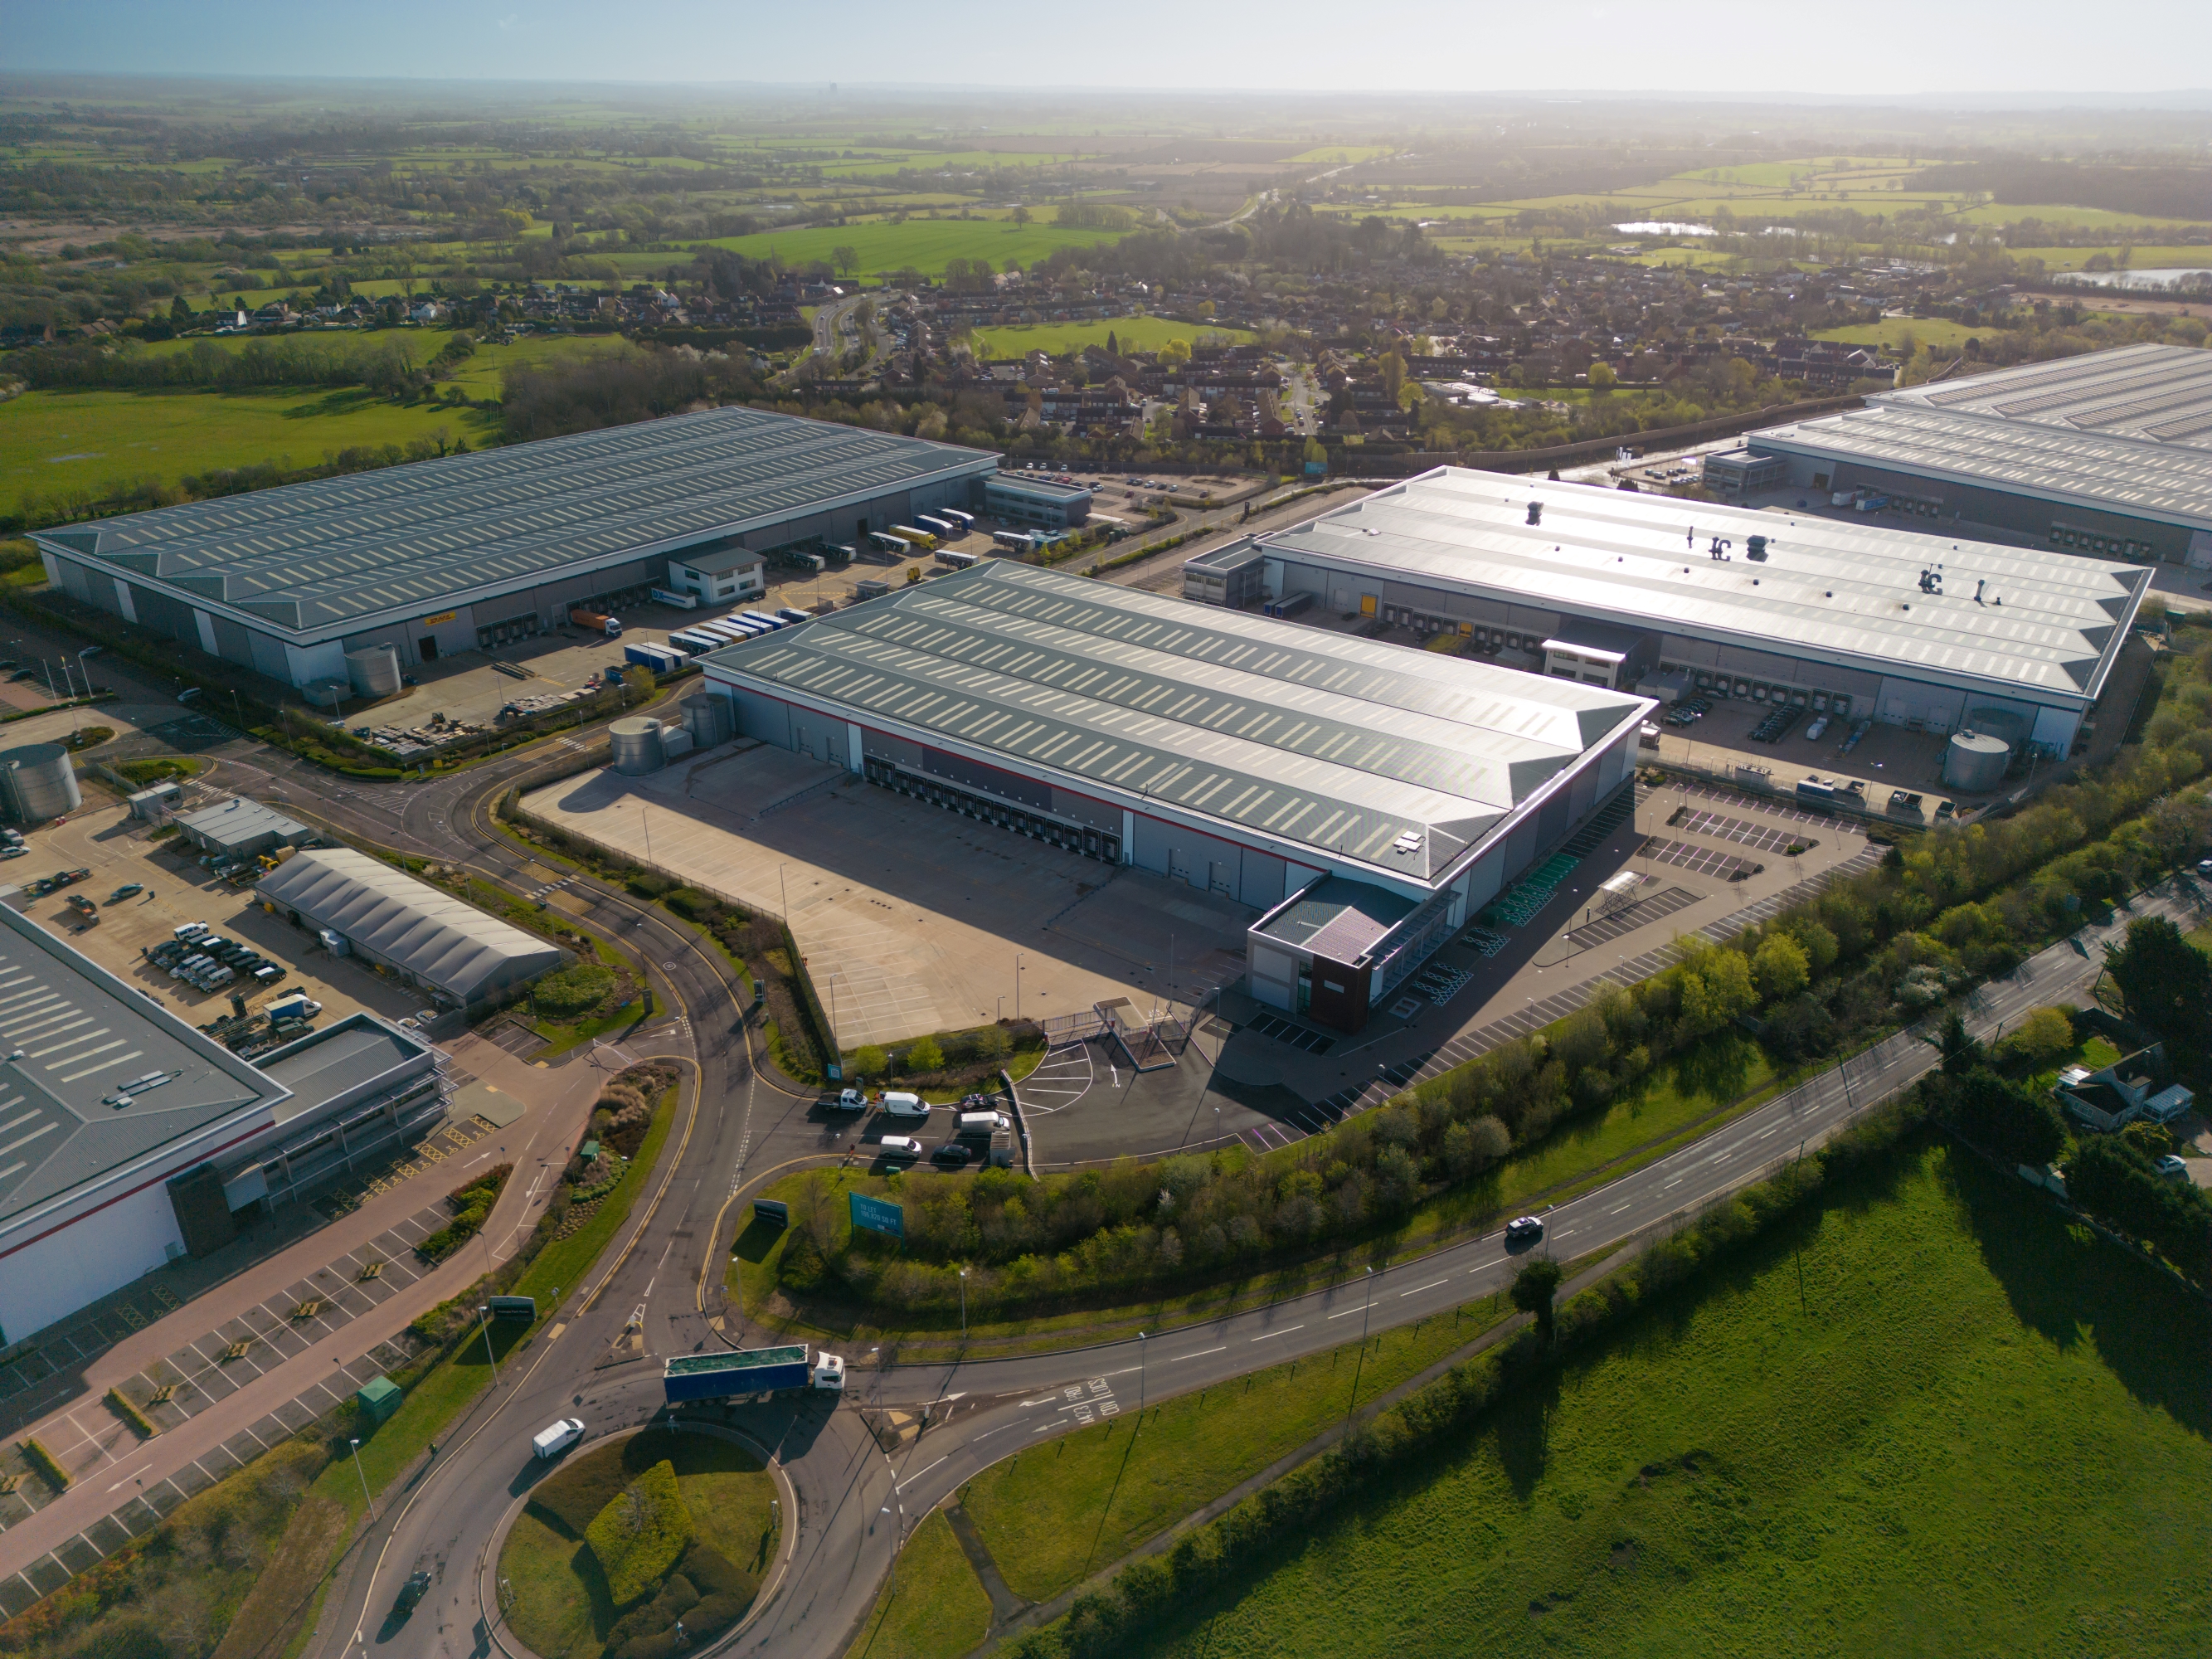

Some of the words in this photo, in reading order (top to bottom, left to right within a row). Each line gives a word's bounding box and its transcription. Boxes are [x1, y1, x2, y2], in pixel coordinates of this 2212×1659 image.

[653, 589, 664, 600] DX
[430, 614, 452, 624] DHL
[890, 1218, 897, 1226] FT
[1064, 1386, 1085, 1402] PRO
[1098, 1400, 1120, 1416] COV
[1073, 1405, 1096, 1425] A423
